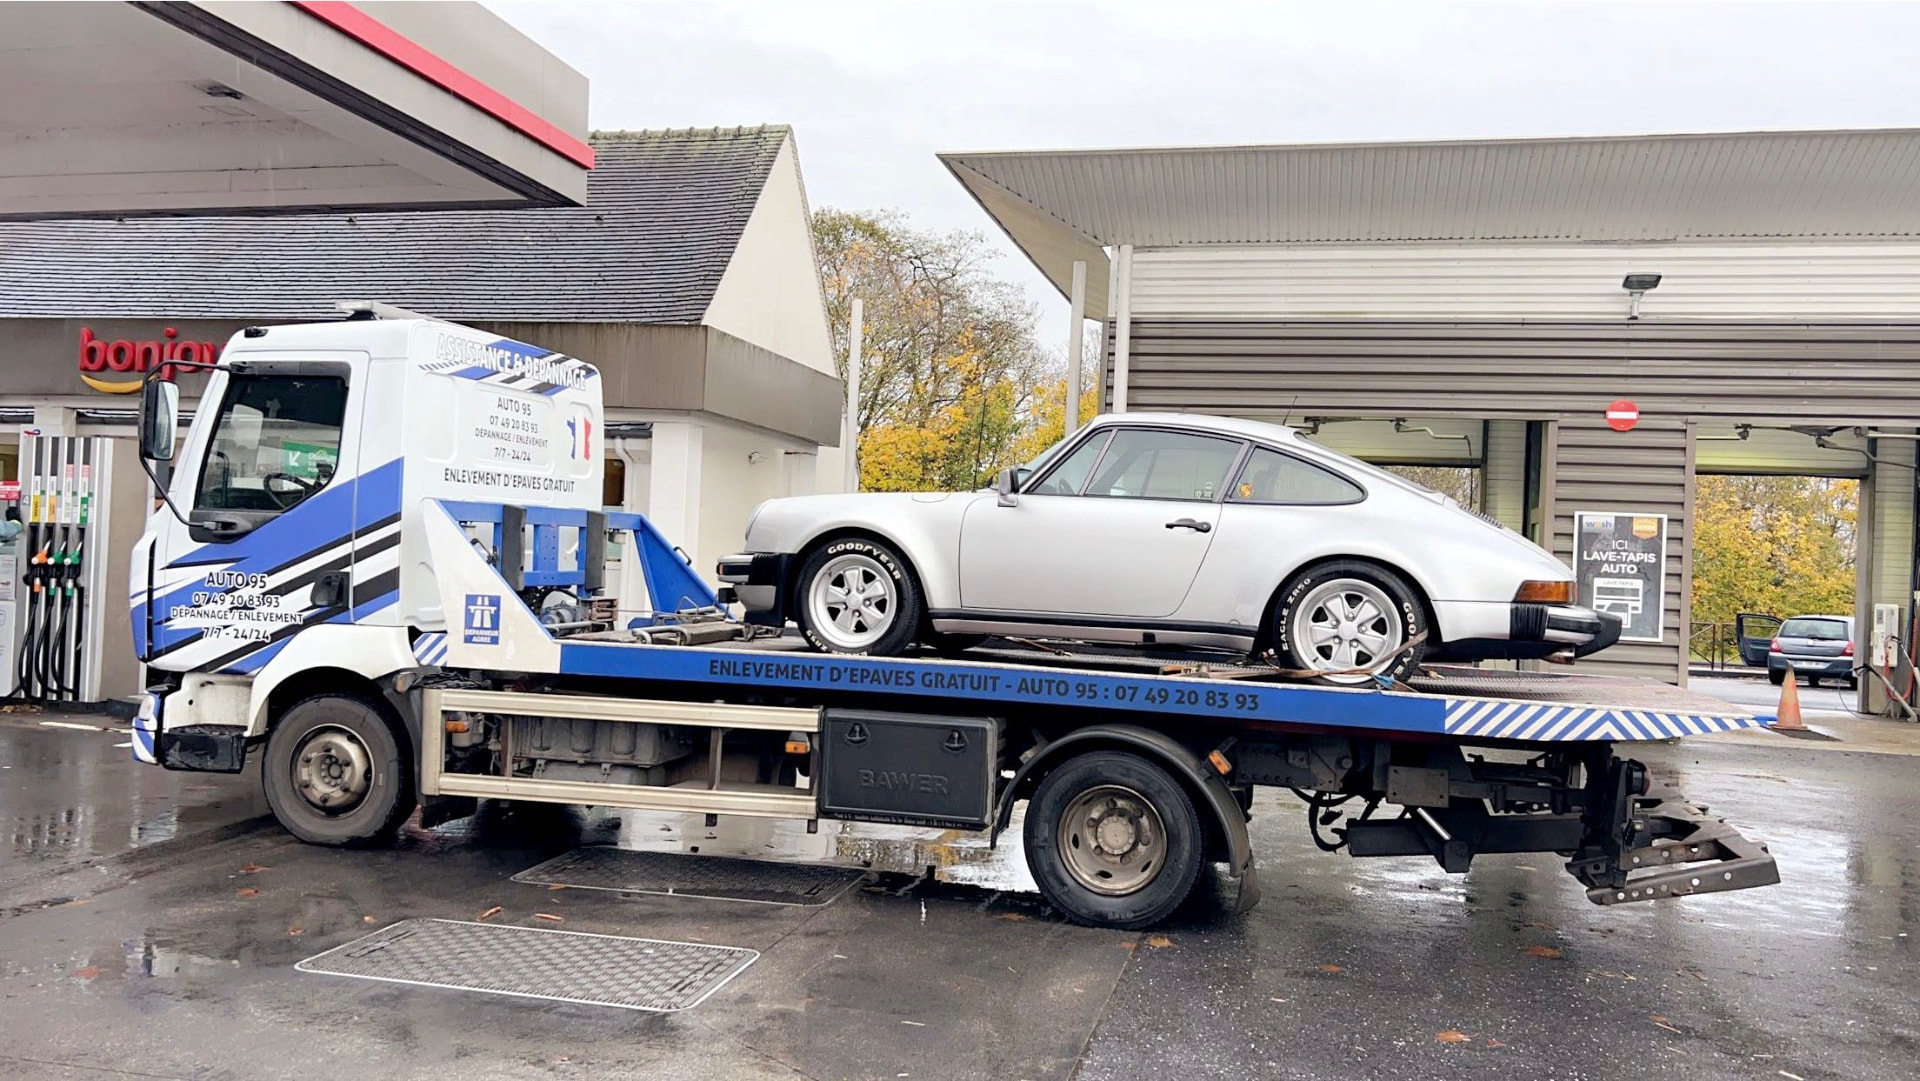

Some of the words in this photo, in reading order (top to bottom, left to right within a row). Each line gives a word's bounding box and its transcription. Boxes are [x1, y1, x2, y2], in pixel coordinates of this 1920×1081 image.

[437, 334, 512, 374] ASSISTANCE
[525, 356, 586, 391] DEPANNAGE
[497, 396, 520, 413] AUTO
[521, 403, 532, 416] 95
[489, 415, 499, 426] 07
[500, 417, 510, 428] 49
[511, 419, 520, 430] 20
[521, 421, 529, 432] 83
[530, 423, 539, 434] 93
[494, 447, 507, 456] 7/7
[511, 449, 531, 462] 24/24
[444, 467, 502, 488] ENLEVEMENT
[503, 474, 541, 490] D'EPAVES
[543, 477, 575, 493] GRATUIT
[1585, 519, 1612, 529] wash
[1612, 540, 1628, 550] ICI
[828, 542, 902, 580] GOODYEAR
[1583, 550, 1656, 563] LAVE-TAPIS
[1601, 563, 1638, 574] AUTO
[206, 571, 245, 588] AUTO
[249, 575, 267, 589] 95
[193, 593, 206, 605] 07
[211, 594, 225, 606] 49
[229, 595, 244, 607] 20
[247, 596, 263, 608] 83
[264, 597, 280, 608] 93
[1279, 608, 1289, 651] EAGLE
[1287, 577, 1311, 605] ZR50
[202, 627, 221, 639] 7/7
[233, 628, 270, 642] 24/24
[709, 659, 825, 681] ENLEVEMENT
[829, 666, 915, 687] D'EPAVES
[921, 672, 1000, 692] GRATUIT
[1017, 677, 1070, 697] AUTO
[1076, 683, 1098, 699] 95
[1114, 686, 1139, 701] 07
[1144, 687, 1169, 704] 49
[1175, 690, 1200, 706] 20
[1205, 691, 1229, 709] 83
[1234, 693, 1259, 711] 93
[858, 769, 949, 796] BAWER
